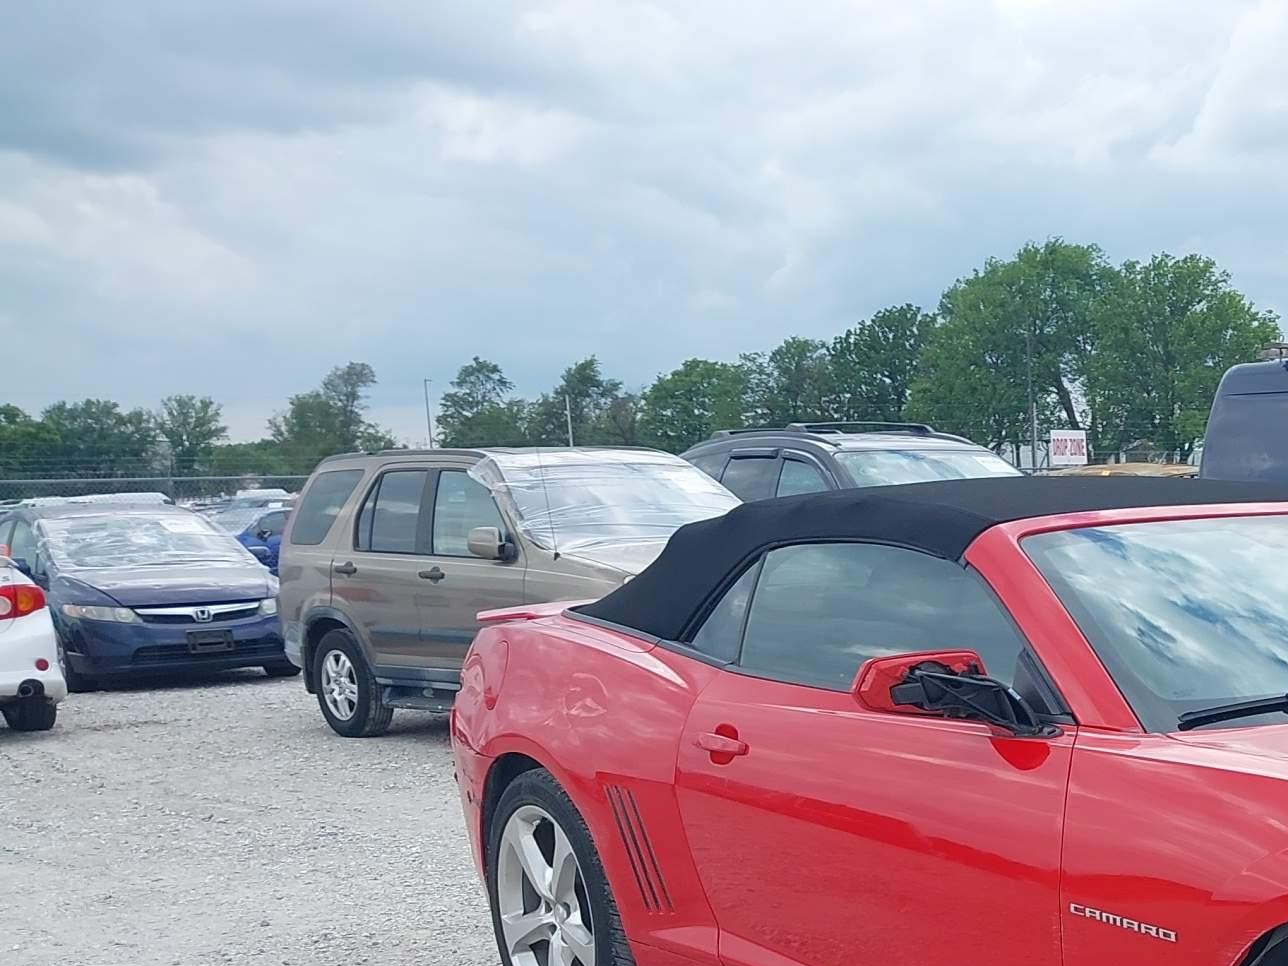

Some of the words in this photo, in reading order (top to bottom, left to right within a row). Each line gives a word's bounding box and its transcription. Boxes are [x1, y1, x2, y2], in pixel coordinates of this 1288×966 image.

[1052, 438, 1068, 456] DROP
[1069, 438, 1085, 456] ZONE
[1069, 903, 1177, 943] CAMARO
